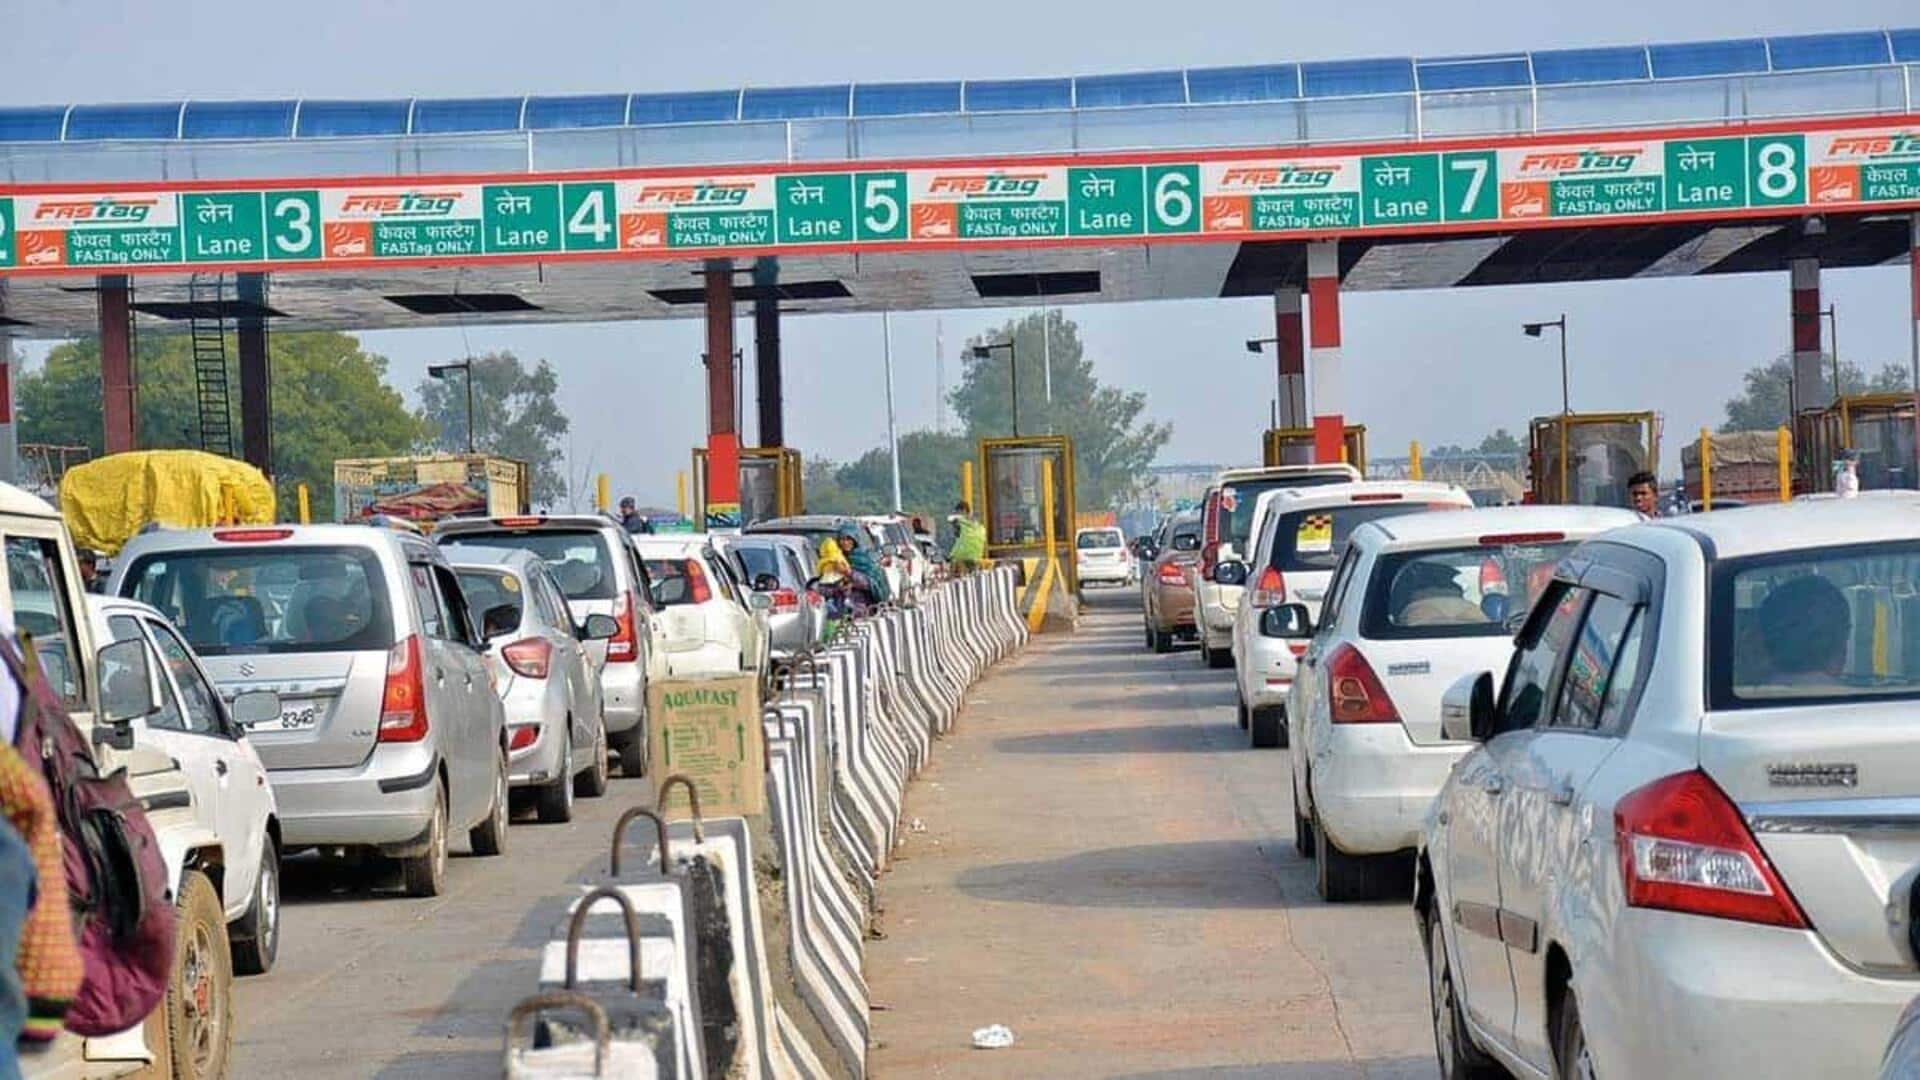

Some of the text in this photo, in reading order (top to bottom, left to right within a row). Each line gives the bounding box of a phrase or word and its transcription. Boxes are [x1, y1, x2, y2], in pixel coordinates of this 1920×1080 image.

[1677, 145, 1716, 171] लेन
[1373, 160, 1411, 186] लेन
[1759, 143, 1796, 198] 8
[788, 180, 825, 205] लेन
[1079, 172, 1115, 198] लेन
[1452, 160, 1488, 213] 7
[1556, 181, 1594, 198] केवल
[1678, 183, 1733, 203] Lane
[495, 189, 532, 215] लेन
[864, 179, 899, 233] 5
[1155, 172, 1192, 226] 6
[1258, 198, 1294, 214] केवल
[1374, 198, 1428, 218] Lane
[1559, 197, 1654, 214] FASTag ONLY
[197, 198, 233, 224] लेन
[568, 190, 612, 242] 4
[965, 205, 1001, 221] केवल
[1079, 210, 1132, 229] Lane
[274, 198, 313, 253] 3
[379, 222, 416, 239] केवल
[672, 214, 710, 231] केवल
[789, 217, 841, 236] Lane
[966, 221, 1057, 237] FASTag ONLY
[1259, 213, 1351, 230] FASTag ONLY
[72, 230, 111, 247] केवल
[198, 235, 251, 255] Lane
[496, 226, 549, 246] Lane
[675, 230, 766, 246] FASTag ONLY
[75, 247, 170, 264] FASTag ONLY
[381, 239, 473, 256] FASTag ONLY
[664, 689, 737, 709] AQUAFAST
